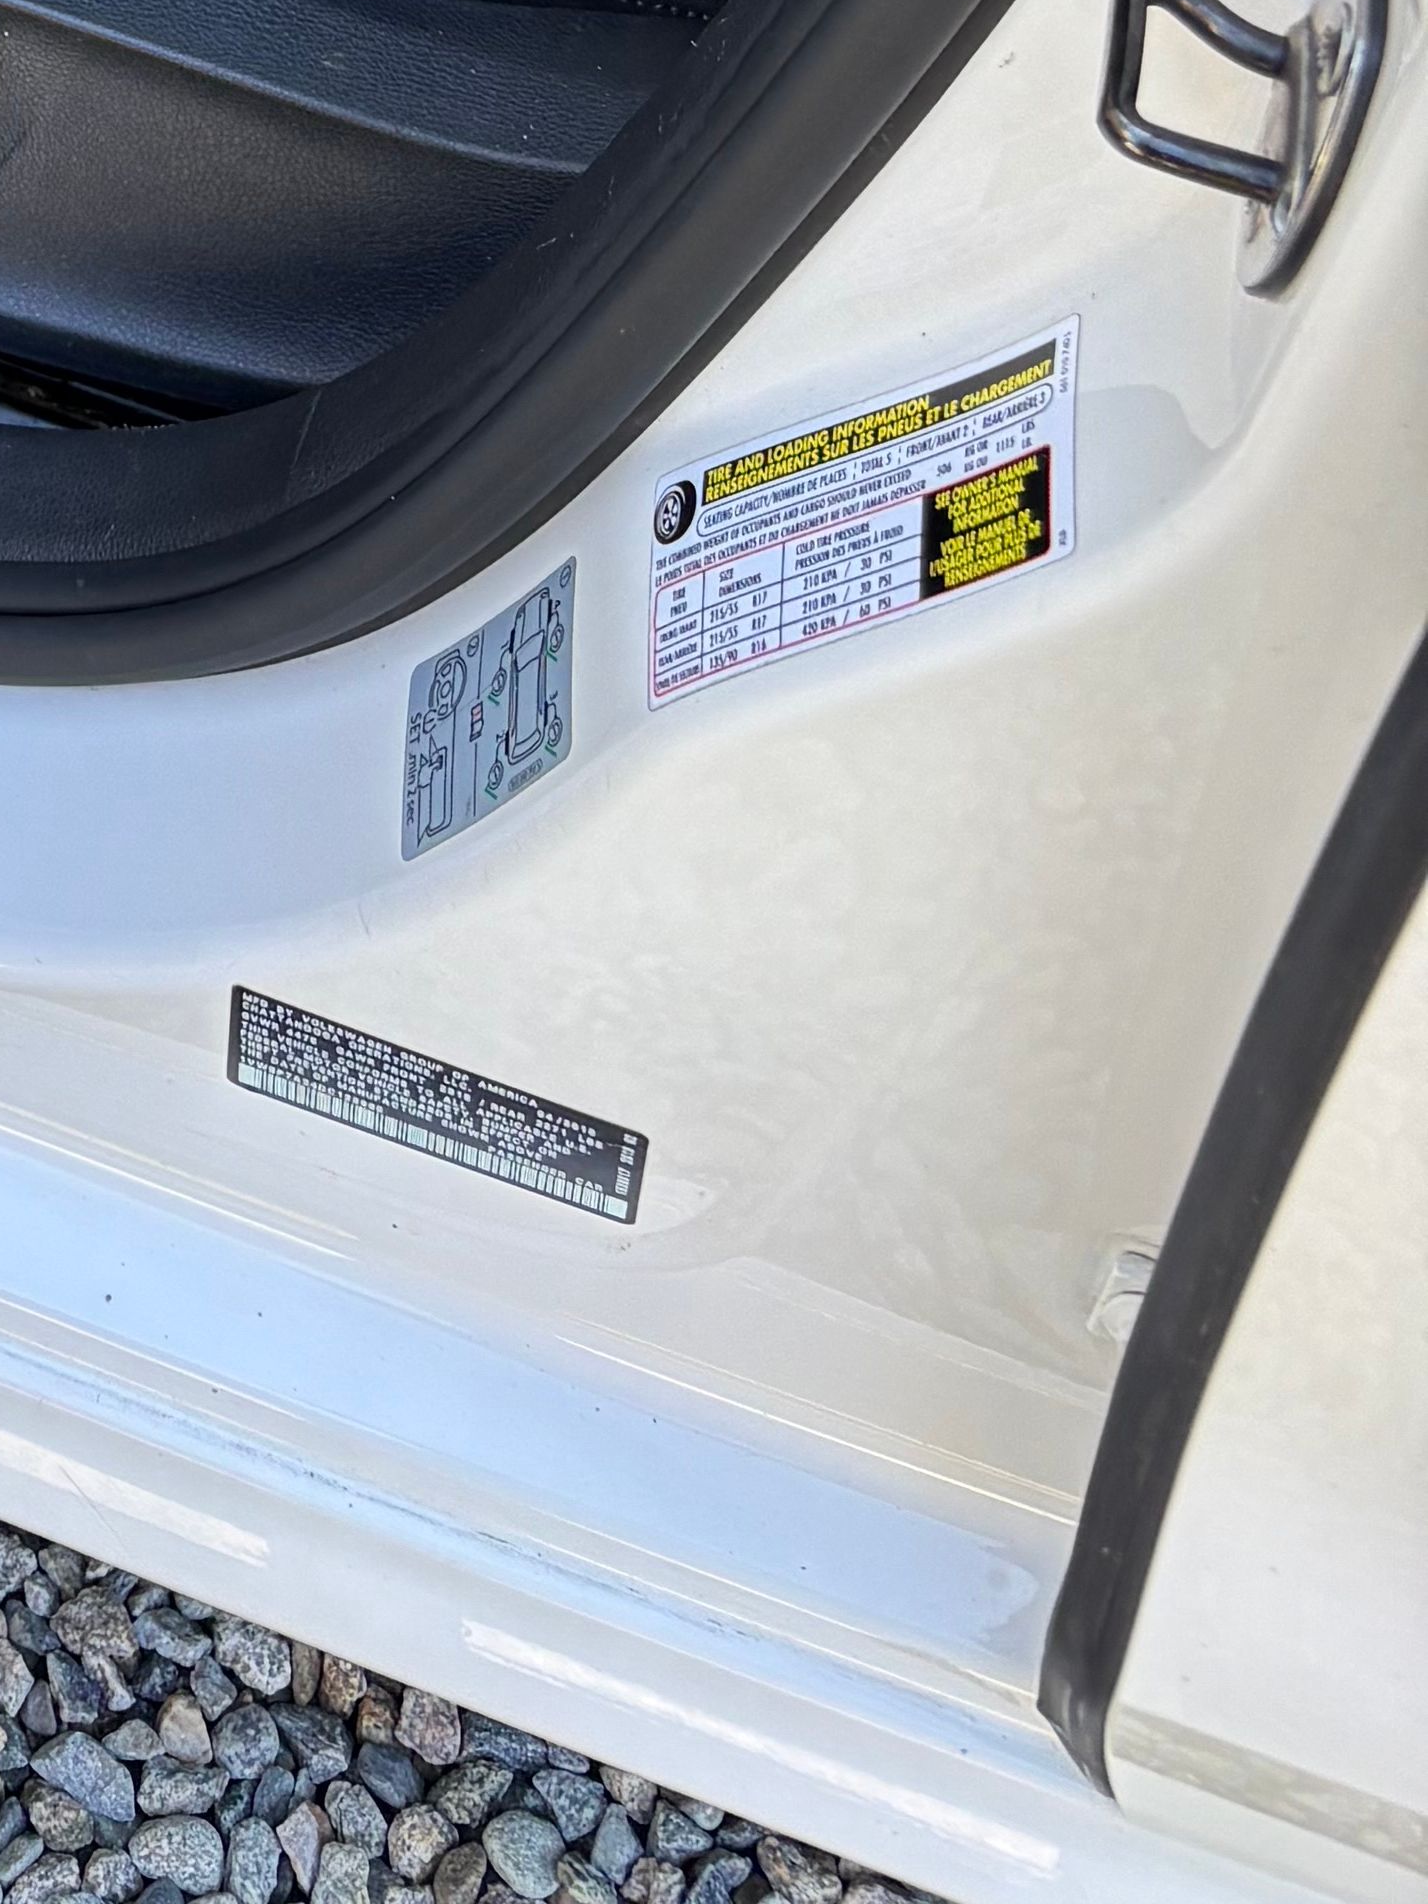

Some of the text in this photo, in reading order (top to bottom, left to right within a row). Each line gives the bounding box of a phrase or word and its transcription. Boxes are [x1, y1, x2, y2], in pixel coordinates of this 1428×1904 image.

[704, 443, 820, 507] RENSEIGNEMENTS
[821, 436, 849, 463] SUR
[852, 428, 874, 452] LES
[877, 411, 923, 444] PNEUS
[925, 404, 941, 425] ET
[943, 398, 957, 419] LE
[960, 357, 1051, 413] CHARGEMENT
[706, 389, 929, 487] TIRE AND LOADING INFORMATION
[905, 425, 960, 459] FRONT/AVANT
[860, 453, 884, 474] TOTAL
[934, 453, 1039, 511] SEE OWNER'S MANUAL
[703, 505, 733, 530] SEATING
[806, 476, 818, 492] DE
[819, 465, 847, 489] PLACES
[780, 509, 828, 540] CHARGEMENT
[862, 490, 888, 512] JAMAIS
[800, 496, 825, 516] CARGO
[827, 485, 857, 508] SHOULD
[858, 477, 882, 497] NEVER
[883, 466, 912, 489] EXCEED
[947, 474, 1026, 521] FOR ADDITIONAL
[952, 492, 1019, 534] INFORMATION
[939, 506, 1031, 558] VOIR LE MANUEL DE
[974, 532, 1003, 561] POUR
[1003, 524, 1027, 550] PLUS
[1027, 517, 1042, 541] DE
[802, 596, 818, 615] 210
[859, 578, 871, 596] 30
[877, 571, 892, 590] PSI
[803, 571, 820, 591] 210
[859, 554, 872, 572] 30
[878, 547, 892, 565] PSI
[708, 623, 738, 648] 215/55
[709, 599, 739, 624] 215/55
[801, 619, 818, 638] 420
[858, 601, 870, 618] 60
[877, 594, 891, 612] PSI
[409, 712, 422, 744] SET
[407, 753, 418, 786] min
[406, 799, 415, 826] sec
[241, 1000, 341, 1044] CHATTANOOGA
[442, 1074, 472, 1093] LLC.
[241, 1010, 279, 1032] GVWR
[335, 1044, 375, 1067] GAWR
[382, 1062, 426, 1086] FRONT
[276, 1004, 294, 1018] BY
[301, 1013, 392, 1055] VOLKSWAGEN
[399, 1049, 444, 1074] GROUP
[451, 1069, 469, 1083] OF
[477, 1078, 538, 1109] AMERICA
[239, 1044, 263, 1060] THE
[270, 1055, 305, 1075] DATE
[312, 1070, 329, 1084] OF
[336, 1080, 433, 1122] MANUFACTURE
[440, 1117, 489, 1143] SHOWN
[497, 1138, 543, 1162] ABOVE
[240, 1019, 269, 1038] THIS
[276, 1032, 329, 1060] VEHICLE
[336, 1055, 408, 1089] CONFORMS
[415, 1084, 434, 1098] TO
[442, 1094, 467, 1110] ALL
[475, 1105, 557, 1143] APPLICABLE
[240, 1027, 295, 1055] FEDERAL
[302, 1051, 349, 1075] MOTOR
[357, 1071, 410, 1098] VEHICLE
[481, 1116, 535, 1143] BUMPER
[542, 1139, 571, 1156] AND
[240, 1035, 278, 1058] THEFT
[285, 1053, 366, 1090] PREVENTION
[373, 1085, 453, 1122] STANDARDS
[480, 1124, 529, 1149] EFFECT
[537, 1145, 557, 1160] ON
[489, 1101, 526, 1122] REAR
[486, 1144, 603, 1193] PASSENGER CAR
